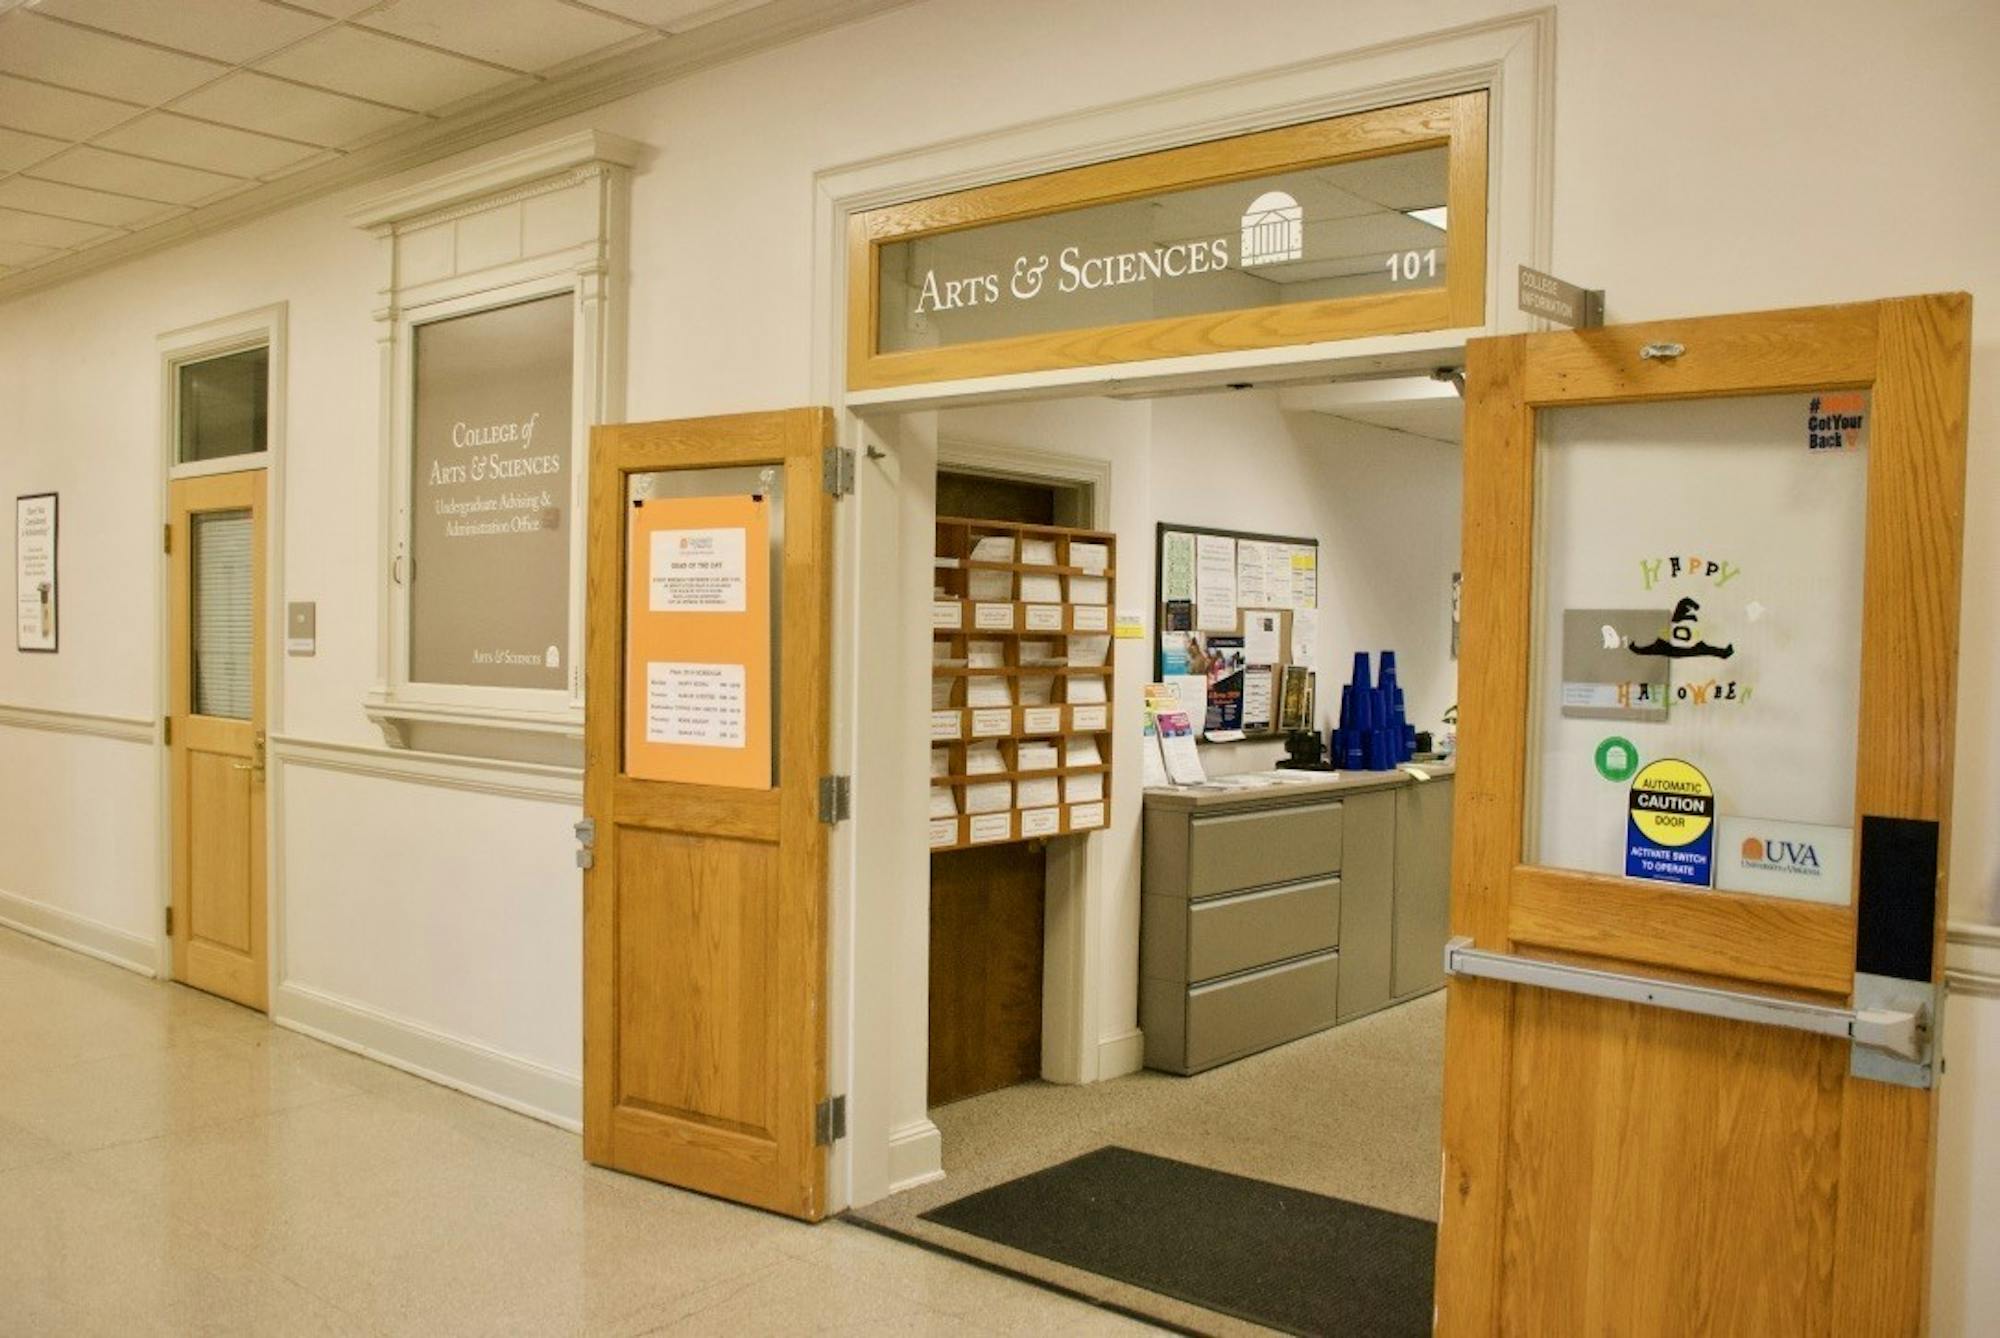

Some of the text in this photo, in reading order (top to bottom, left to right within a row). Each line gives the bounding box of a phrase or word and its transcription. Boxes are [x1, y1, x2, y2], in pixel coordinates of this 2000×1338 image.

[1010, 255, 1050, 299] &
[1385, 248, 1437, 282] 101
[1521, 271, 1558, 295] COLLEGE
[520, 412, 540, 449] of
[1809, 431, 1842, 449] Back
[471, 456, 488, 482] &
[436, 490, 553, 517] Undergraduate Advising &
[445, 515, 541, 537] Administration Office
[1639, 556, 1741, 590] HAPPY
[1616, 678, 1755, 709] HALLOWEEN
[1642, 778, 1703, 794] AUTOMATIC
[1638, 795, 1705, 813] CAUTION
[1654, 814, 1686, 828] DOOR
[1631, 846, 1707, 865] ACTIVATE SWITCH
[1764, 839, 1820, 867] UVA
[1641, 859, 1695, 876] TO OPERATE
